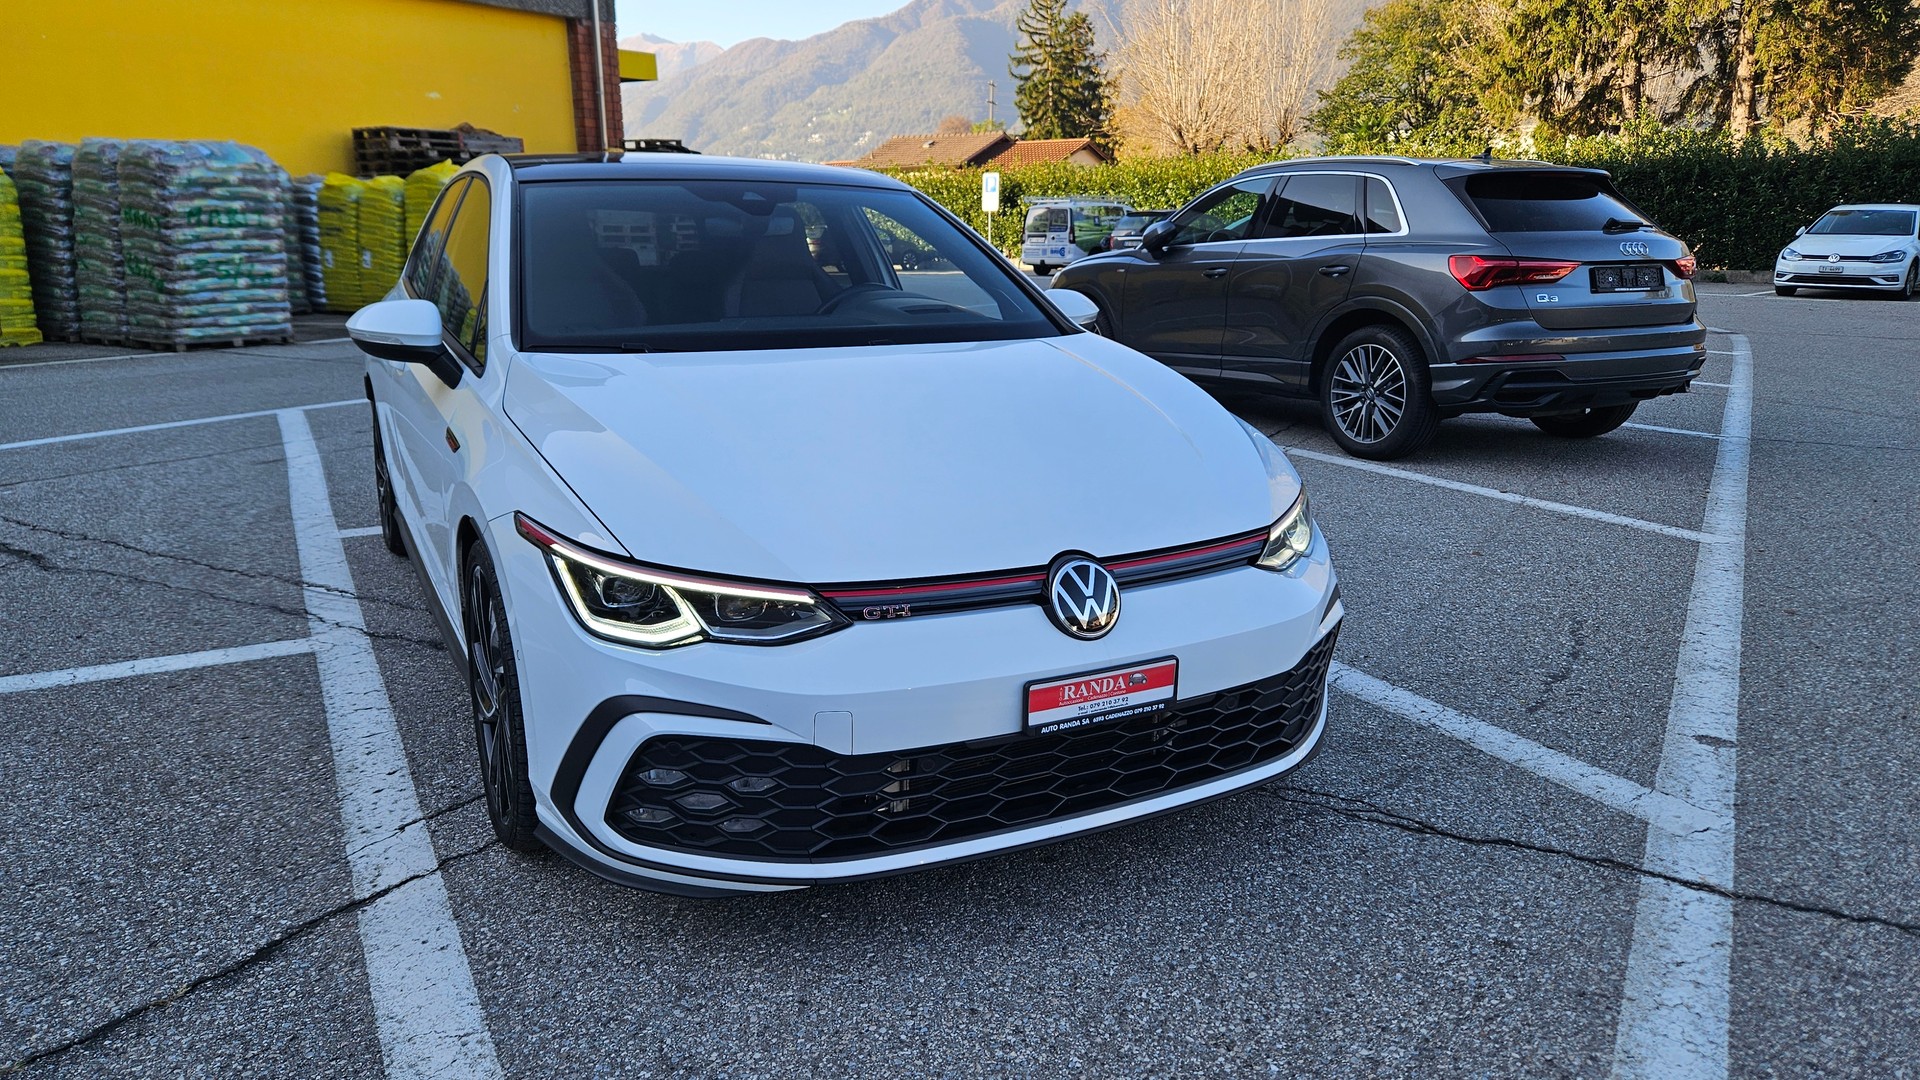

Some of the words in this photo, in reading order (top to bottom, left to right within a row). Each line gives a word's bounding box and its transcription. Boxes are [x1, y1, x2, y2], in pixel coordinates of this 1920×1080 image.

[1536, 293, 1559, 303] Q3
[863, 603, 911, 620] GTI
[1063, 676, 1126, 700] RANDA
[1041, 724, 1058, 734] AUTO
[1059, 720, 1081, 730] RANDA
[1082, 717, 1090, 726] SA
